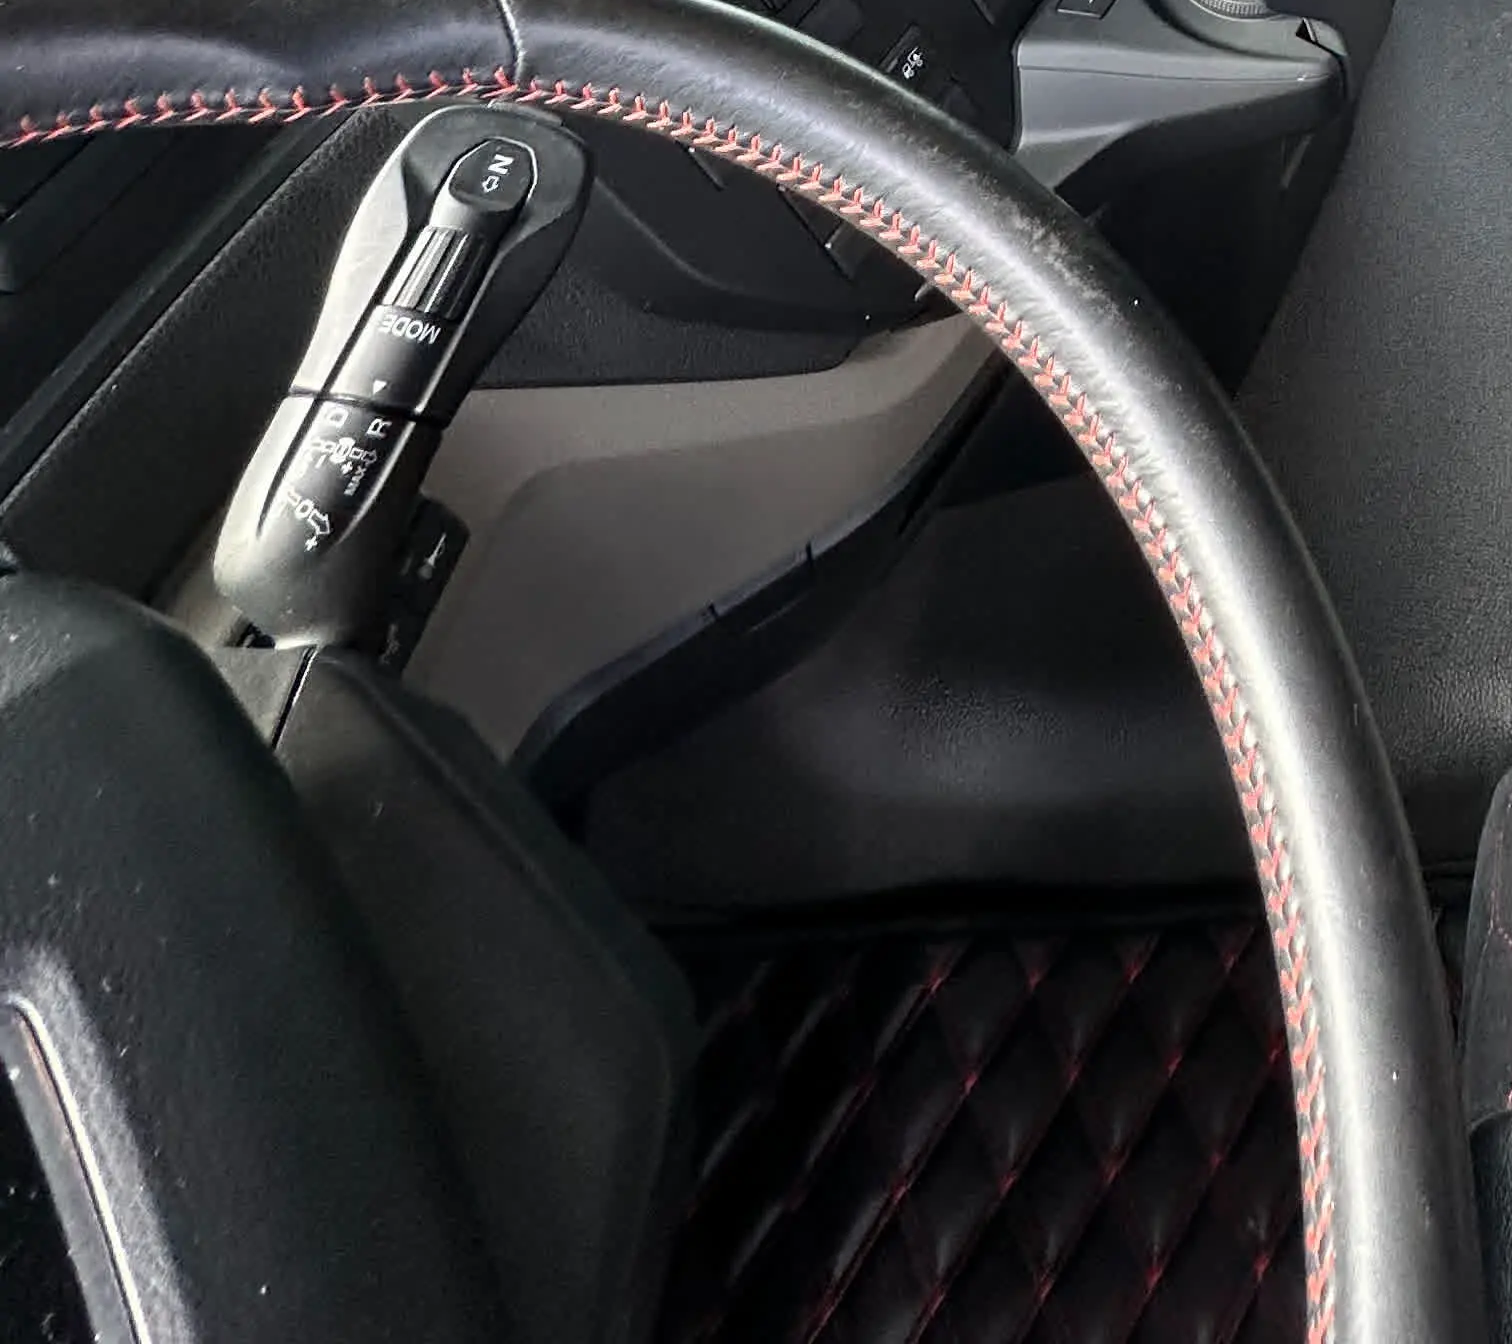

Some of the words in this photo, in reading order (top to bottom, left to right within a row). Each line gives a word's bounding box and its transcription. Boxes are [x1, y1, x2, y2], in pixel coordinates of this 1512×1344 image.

[488, 153, 514, 175] N
[379, 314, 442, 345] MODE
[366, 417, 392, 439] R
